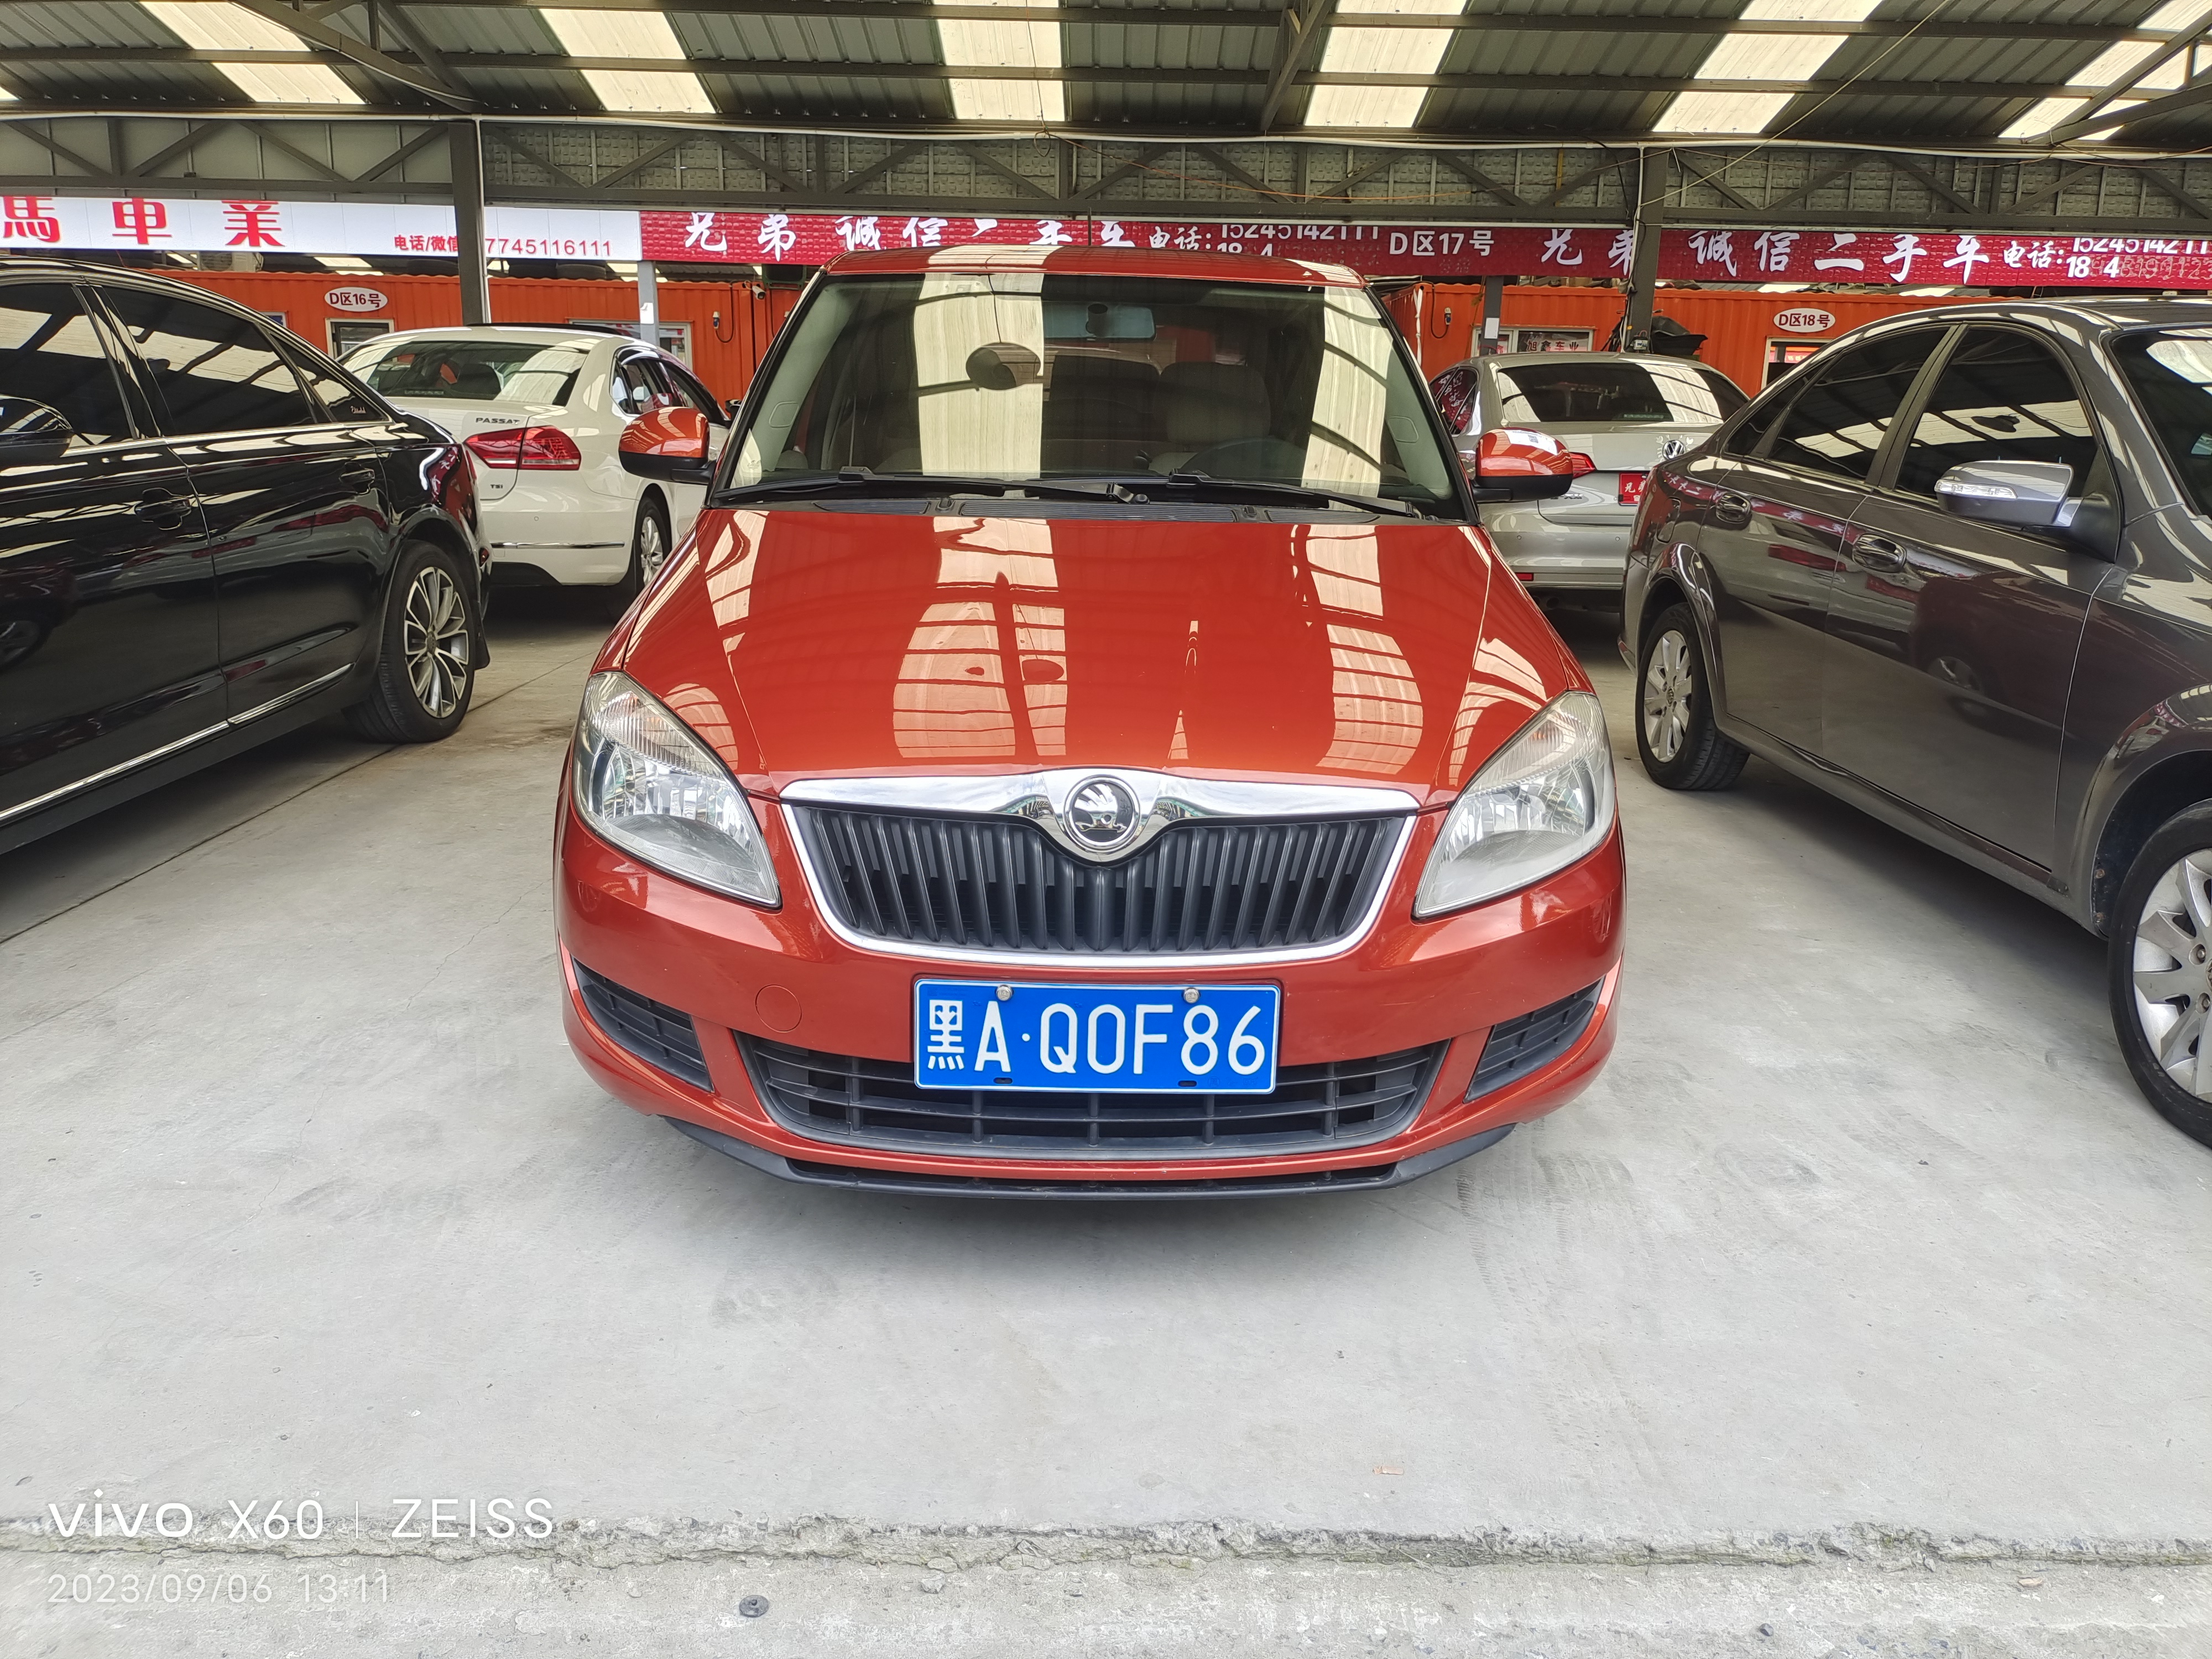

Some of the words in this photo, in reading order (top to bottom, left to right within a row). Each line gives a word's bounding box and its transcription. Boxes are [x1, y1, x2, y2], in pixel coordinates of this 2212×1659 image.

[1389, 230, 1495, 256] D区17号
[329, 292, 382, 308] D区16号
[1778, 313, 1830, 328] D区18号
